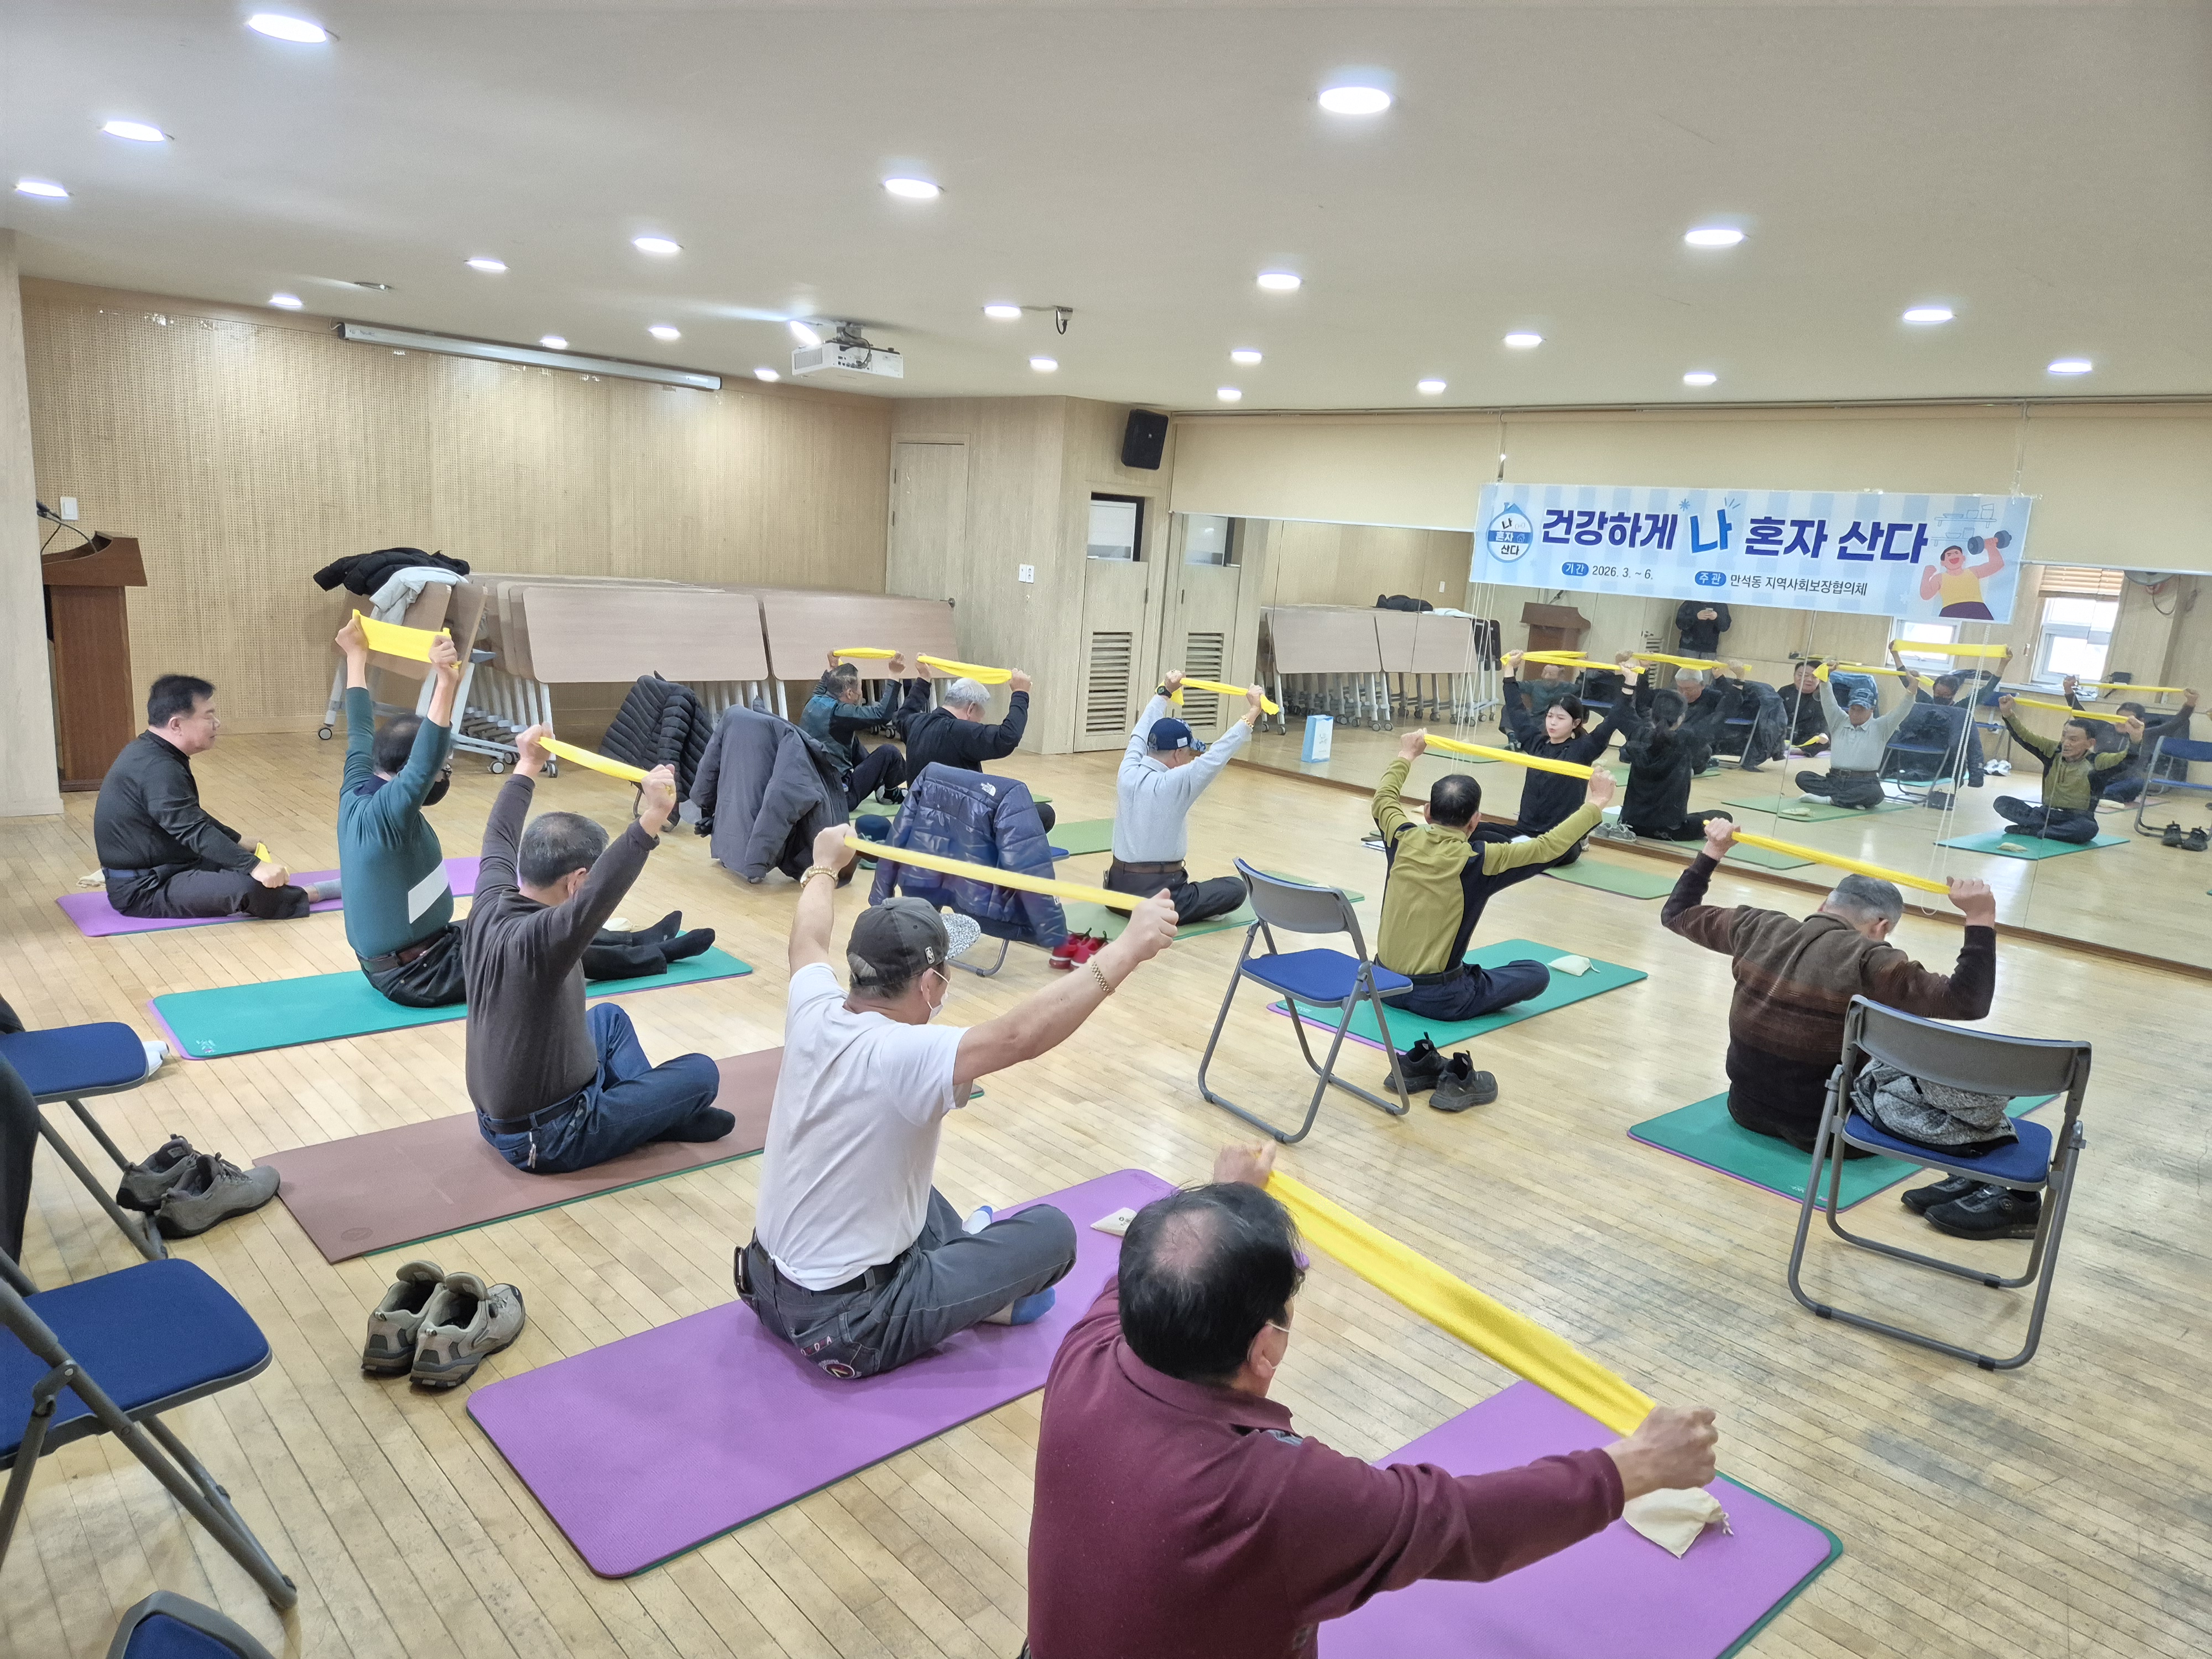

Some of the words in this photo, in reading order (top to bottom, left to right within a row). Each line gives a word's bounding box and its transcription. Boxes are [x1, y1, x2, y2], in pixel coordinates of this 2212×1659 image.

[1501, 518, 1512, 529] 나
[1495, 531, 1514, 542] 혼자
[1542, 509, 1678, 550] 건강하게
[1690, 509, 1732, 554] 나
[1745, 517, 1828, 558] 혼자
[1837, 521, 1928, 564] 산다
[1501, 544, 1520, 555] 산다
[1592, 566, 1619, 577] 2026.
[1730, 574, 1762, 588] 만석동
[1765, 576, 1867, 596] 지역사회보장협의체
